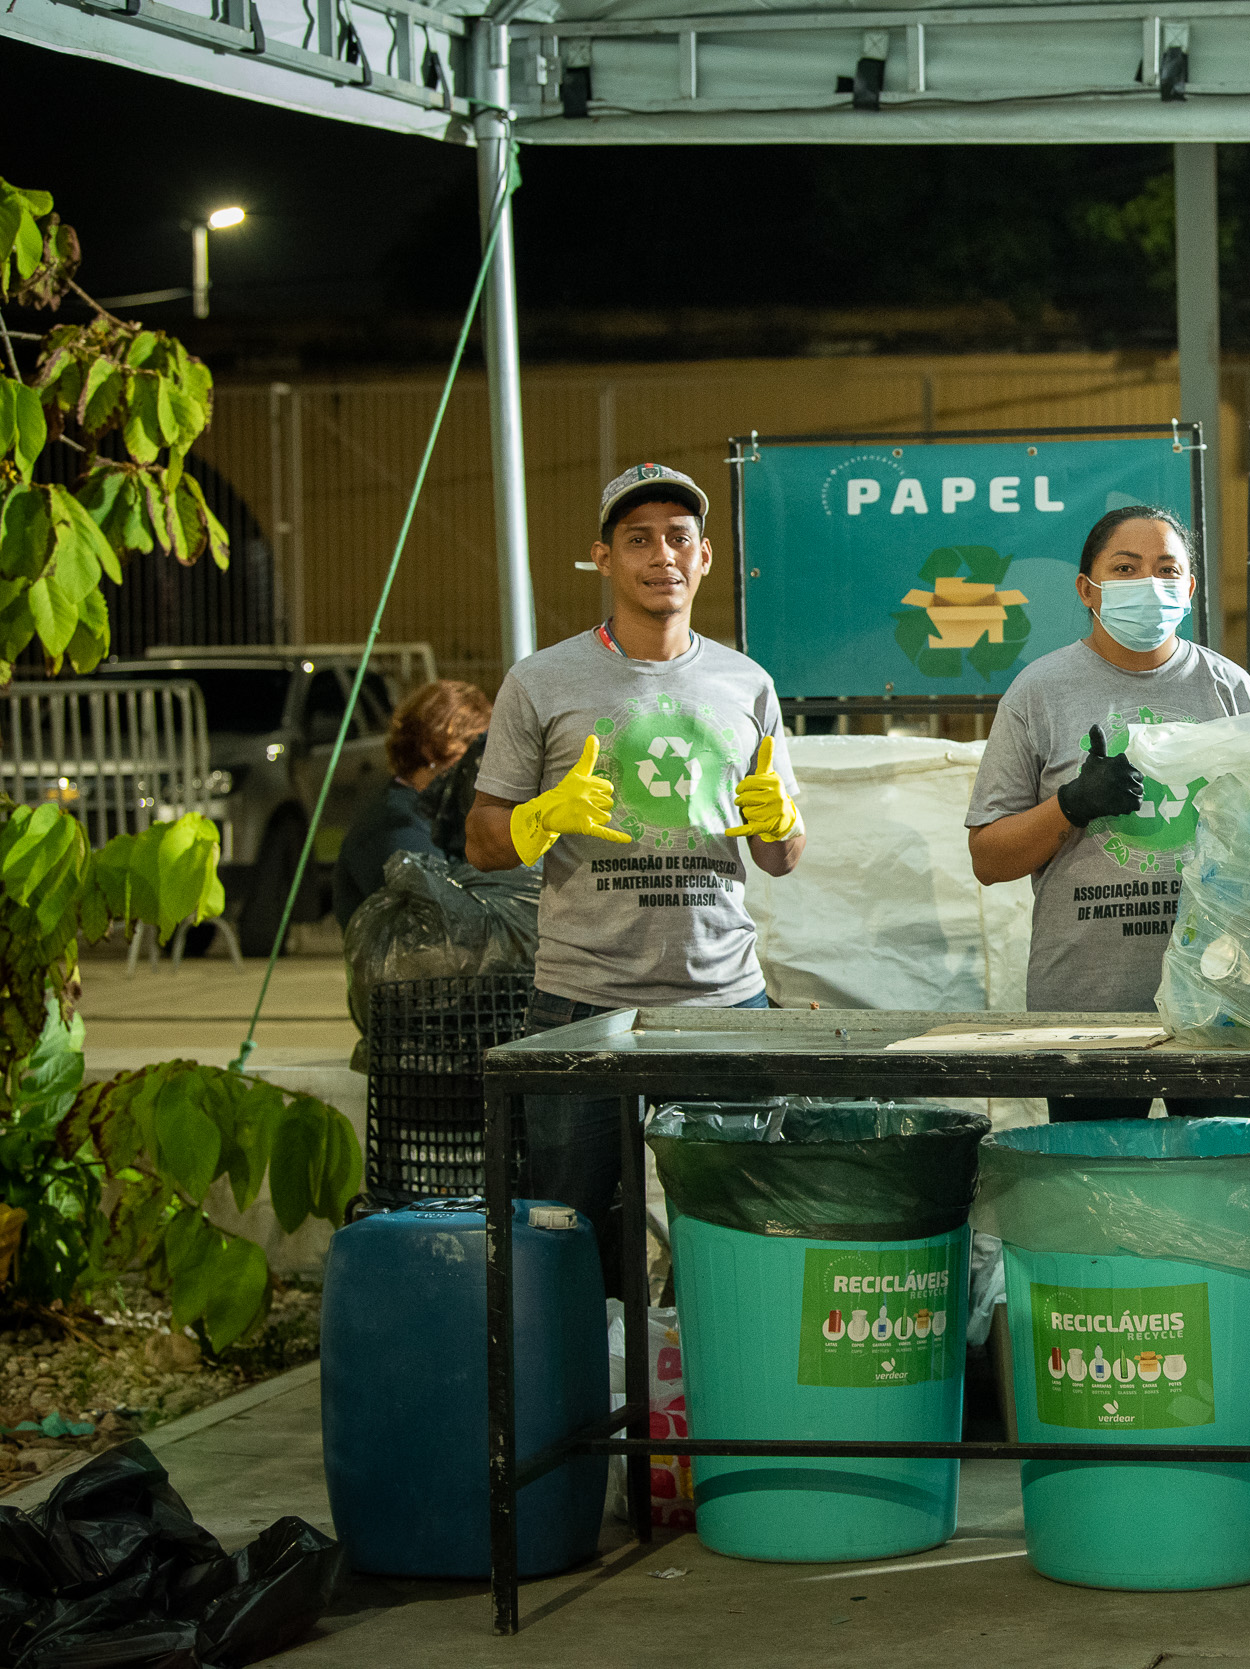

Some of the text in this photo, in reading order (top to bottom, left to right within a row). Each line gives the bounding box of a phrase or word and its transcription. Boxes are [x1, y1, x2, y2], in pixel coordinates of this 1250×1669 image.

[847, 476, 1065, 515] PAPEL
[591, 854, 663, 874] ASSOCIAÇÃO
[665, 856, 680, 870] DE
[596, 877, 610, 891] DE
[612, 875, 673, 891] MATERIAIS
[1073, 880, 1149, 901] ASSOCIAÇÃO
[1152, 881, 1168, 895] DE
[638, 893, 716, 907] MOURA BRASIL
[1077, 906, 1091, 921] DE
[1092, 901, 1160, 919] MATERIAIS
[1122, 920, 1168, 936] MOURA
[833, 1269, 949, 1293] RECICLÁVEIS
[1051, 1310, 1185, 1333] RECICLÁVEIS
[1127, 1329, 1184, 1341] RECYCLE
[875, 1371, 908, 1380] verdear
[1098, 1414, 1136, 1423] verdear
